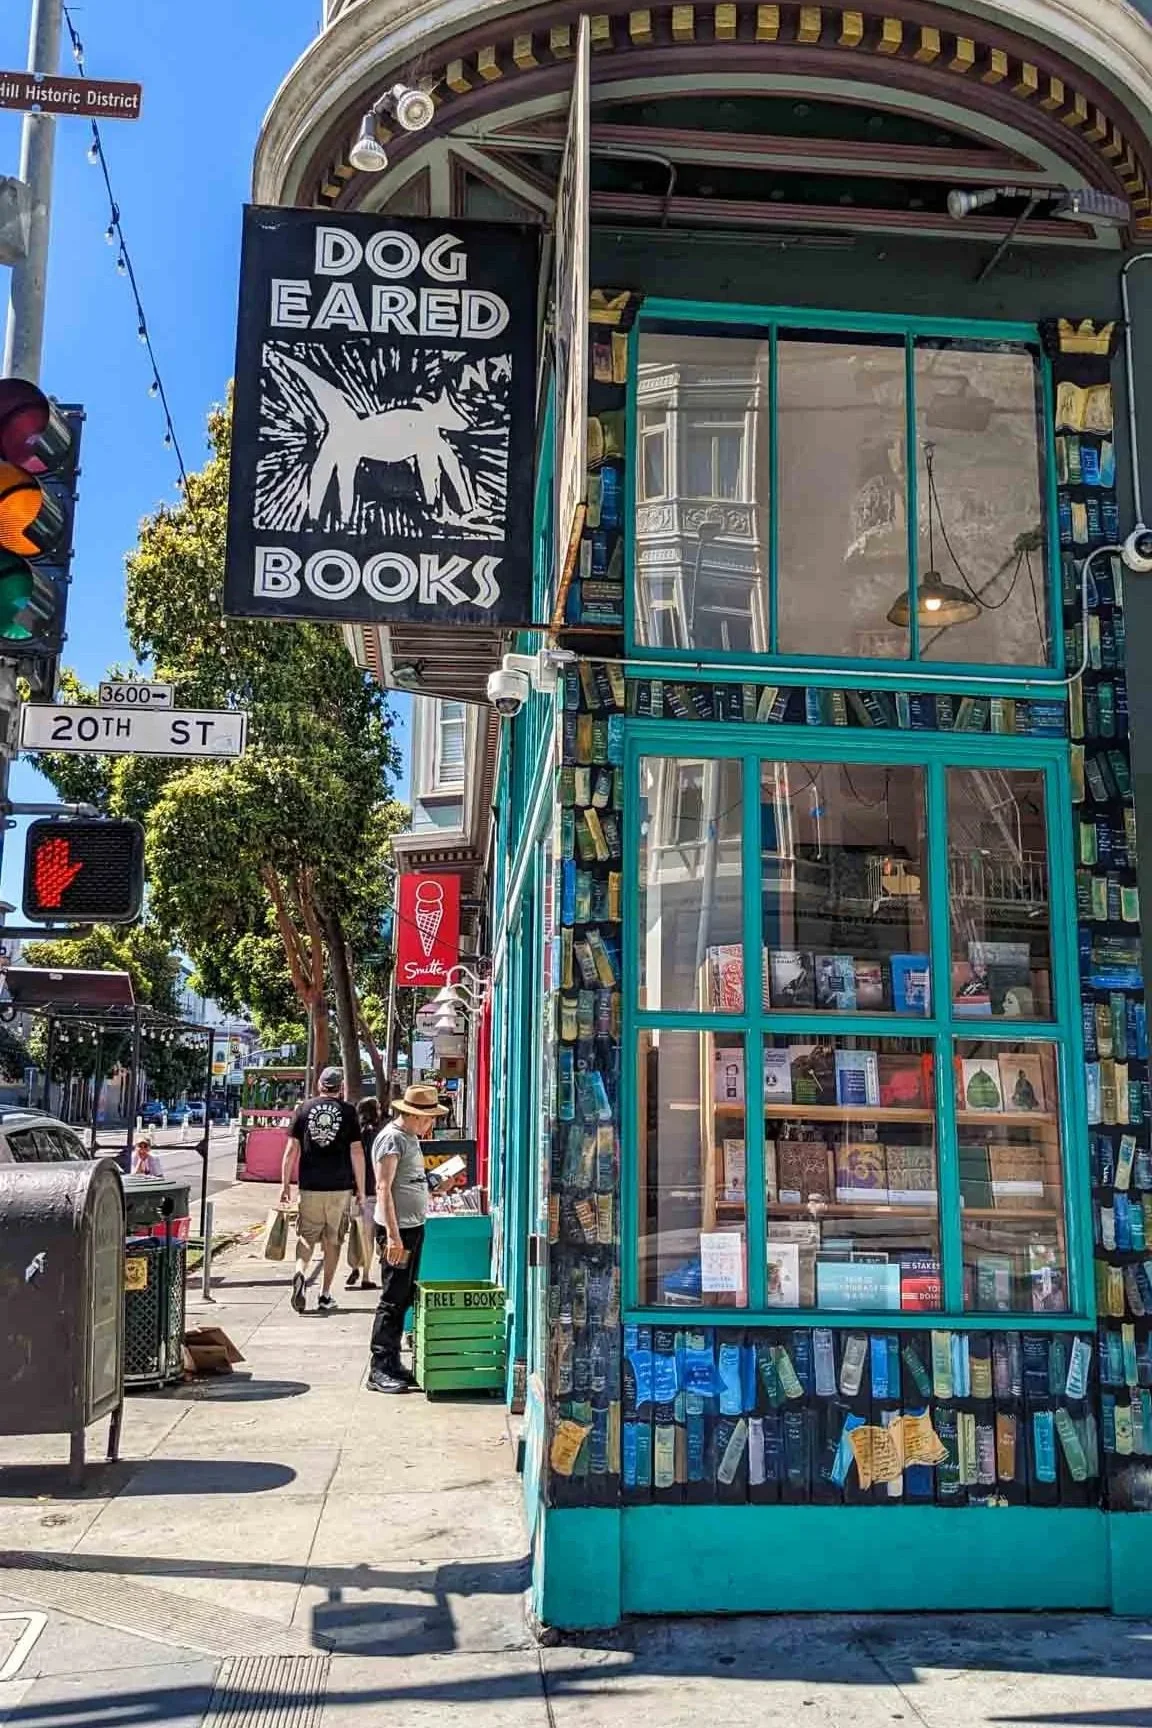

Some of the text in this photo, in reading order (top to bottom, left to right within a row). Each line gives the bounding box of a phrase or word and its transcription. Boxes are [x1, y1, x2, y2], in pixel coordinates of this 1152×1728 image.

[25, 84, 81, 104] Historic
[87, 90, 138, 109] District
[314, 226, 468, 282] DOG
[270, 278, 510, 340] EARED
[253, 546, 503, 609] BOOKS
[101, 686, 151, 703] 3600
[51, 715, 215, 746] 20TH ST
[425, 1291, 505, 1308] FREE BOOKS
